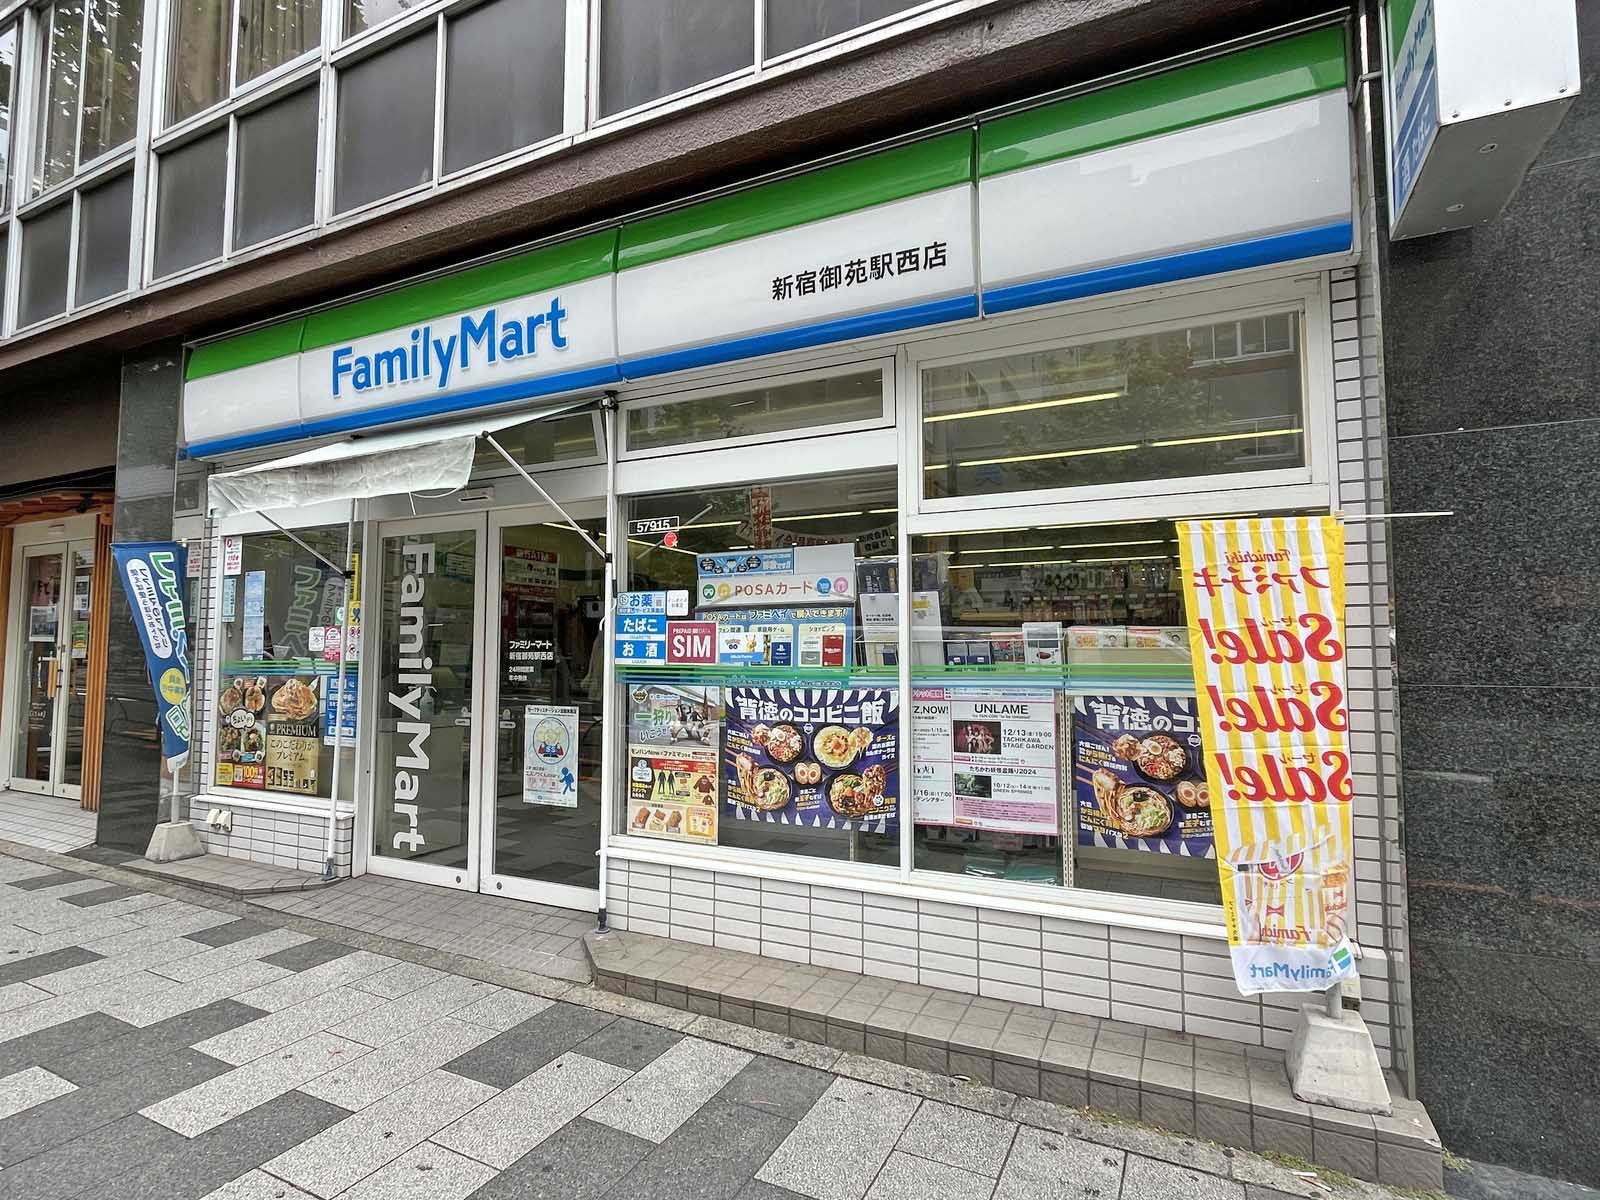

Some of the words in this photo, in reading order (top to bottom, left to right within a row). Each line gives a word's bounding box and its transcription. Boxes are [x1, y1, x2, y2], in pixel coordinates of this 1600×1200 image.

[772, 241, 947, 300] 新宿御苑駅西店
[332, 296, 567, 396] FamilyMart
[636, 519, 670, 533] 57915
[735, 580, 813, 597] POSAカード
[630, 593, 653, 607] お薬
[623, 617, 658, 632] たばこ
[508, 640, 553, 650] ファミリーマート
[622, 642, 658, 657] お酒
[673, 635, 711, 658] SIM
[388, 543, 436, 852] FamilyMart
[735, 696, 886, 725] 背徳のコンビニ飯
[974, 703, 1029, 715] UNLAME
[1089, 701, 1199, 732] 背徳のコ
[276, 723, 317, 737] PREMIUM
[1003, 728, 1026, 737] 12/13
[277, 752, 305, 761] プレミアム
